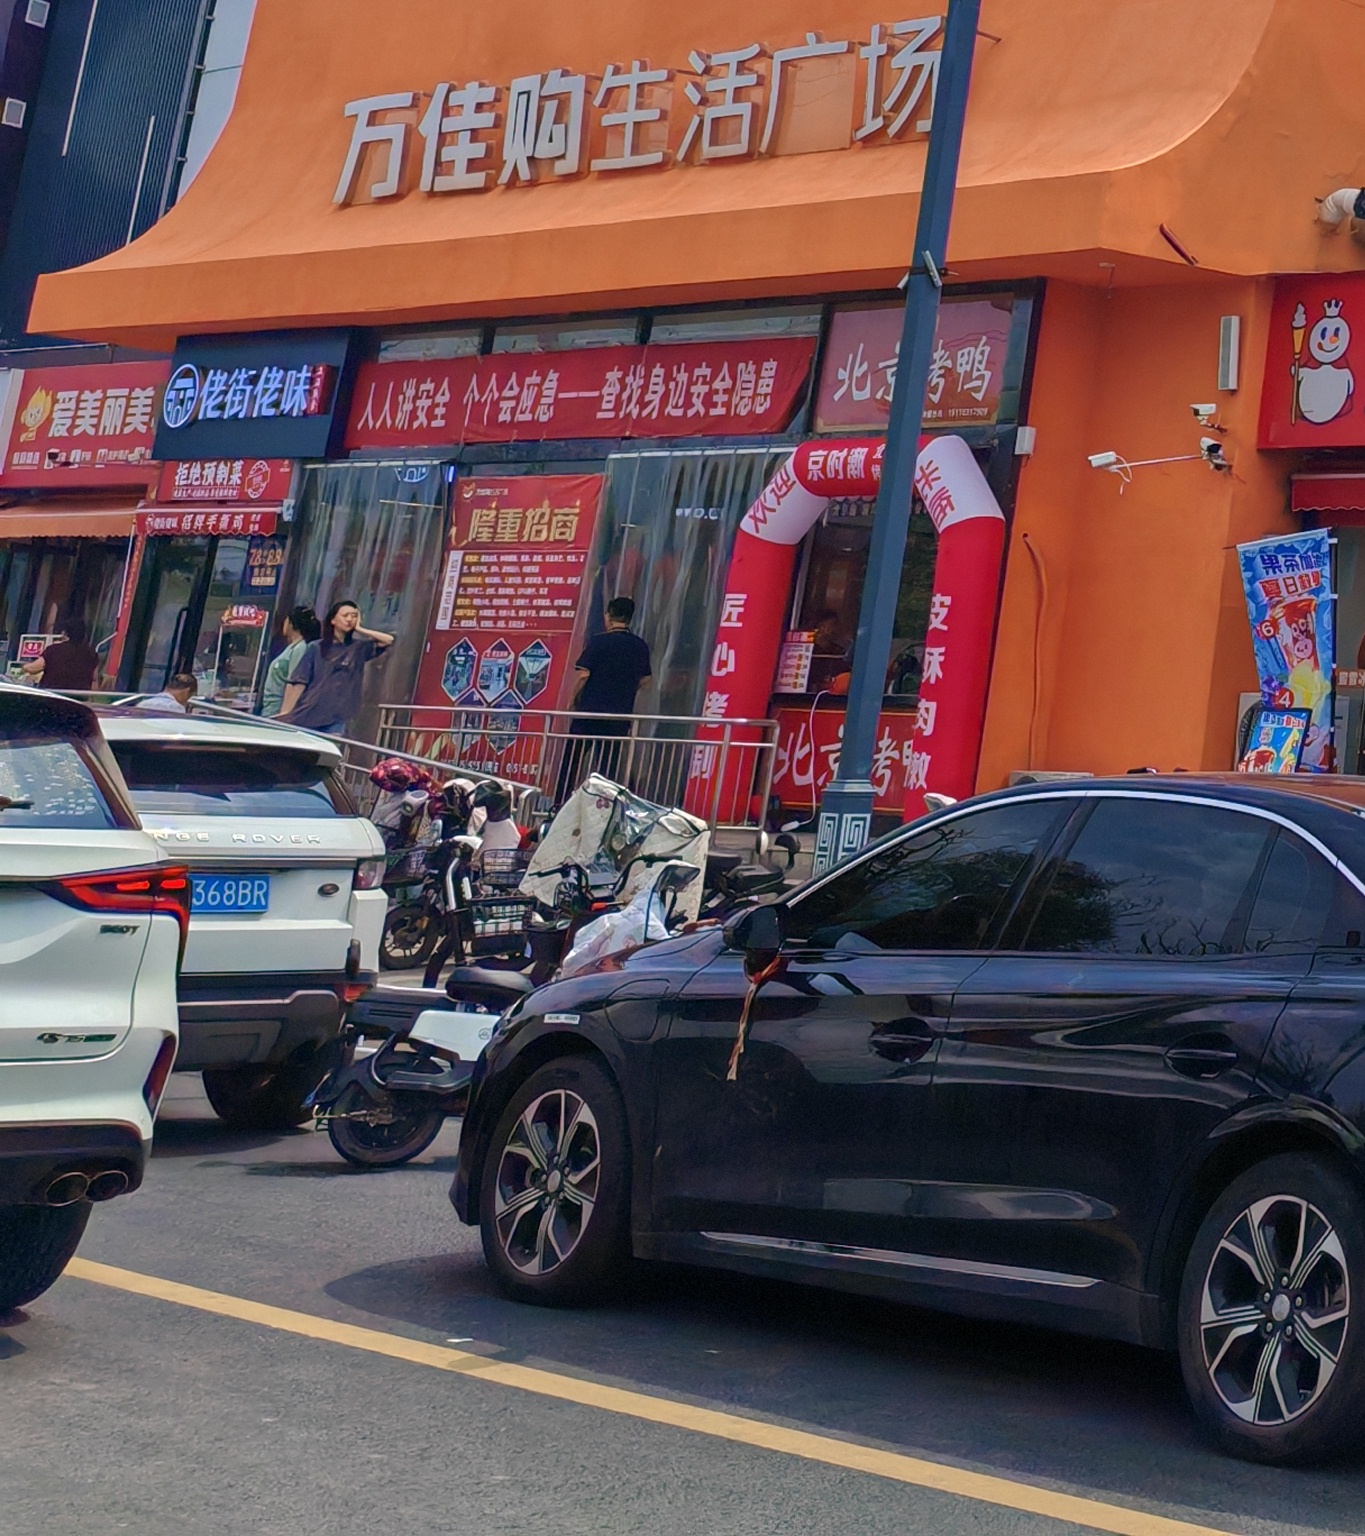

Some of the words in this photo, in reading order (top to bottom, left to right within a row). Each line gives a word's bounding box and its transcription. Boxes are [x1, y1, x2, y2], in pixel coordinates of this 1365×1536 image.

[332, 15, 948, 206] 万佳购生活广场
[48, 385, 156, 439] 爱美丽美
[357, 376, 450, 431] 人人讲安全
[467, 501, 581, 543] 隆重招商
[153, 830, 210, 843] NGE
[232, 832, 322, 845] ROVER
